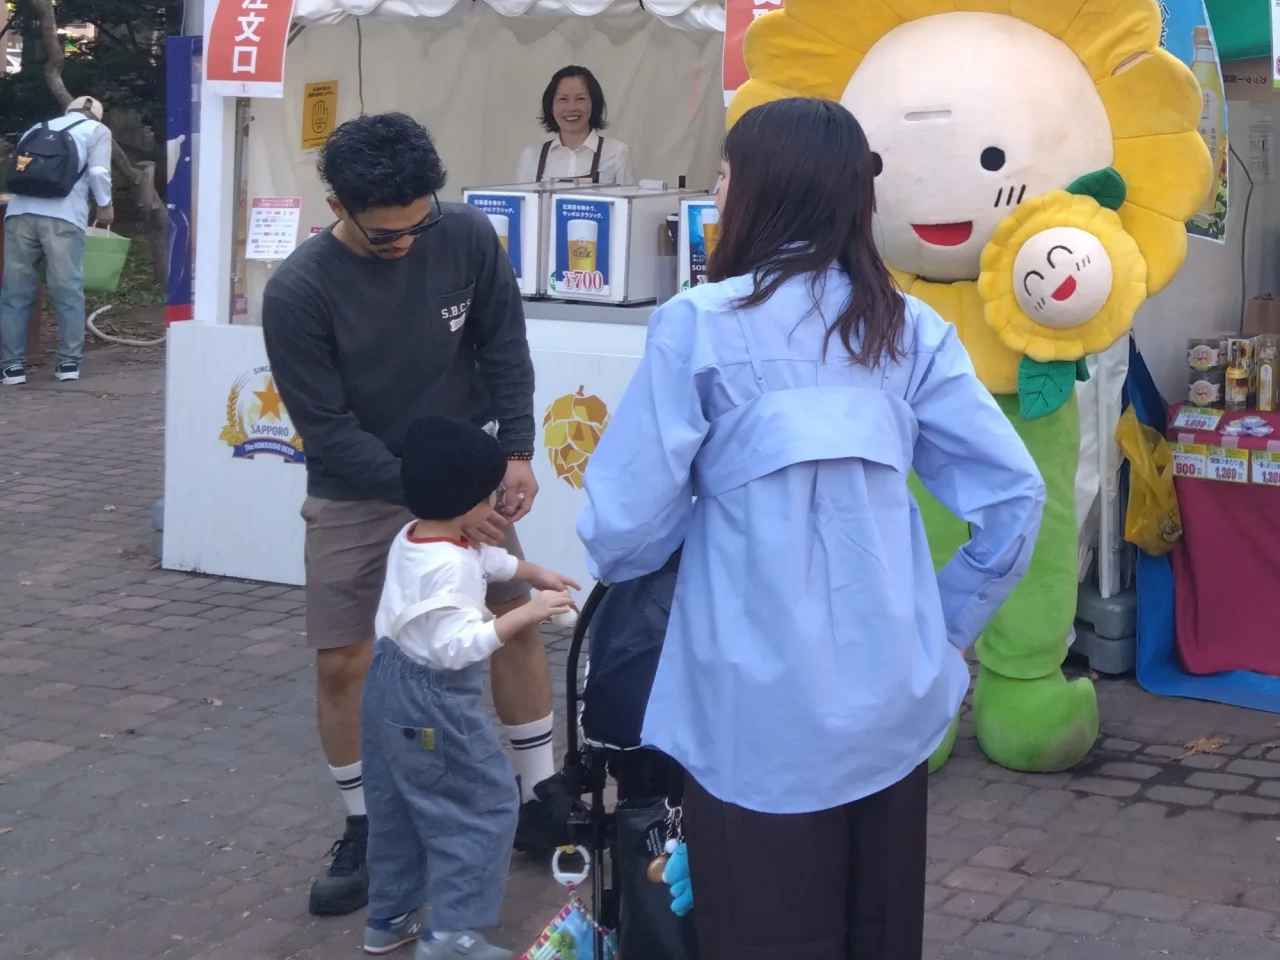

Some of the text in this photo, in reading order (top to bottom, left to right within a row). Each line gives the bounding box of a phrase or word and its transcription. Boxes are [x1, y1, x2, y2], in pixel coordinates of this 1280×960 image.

[563, 270, 603, 290] ¥700
[251, 424, 289, 437] SAPPORO
[254, 441, 280, 451] HOKKAIDO
[281, 445, 295, 456] BEER
[1175, 462, 1196, 475] 500
